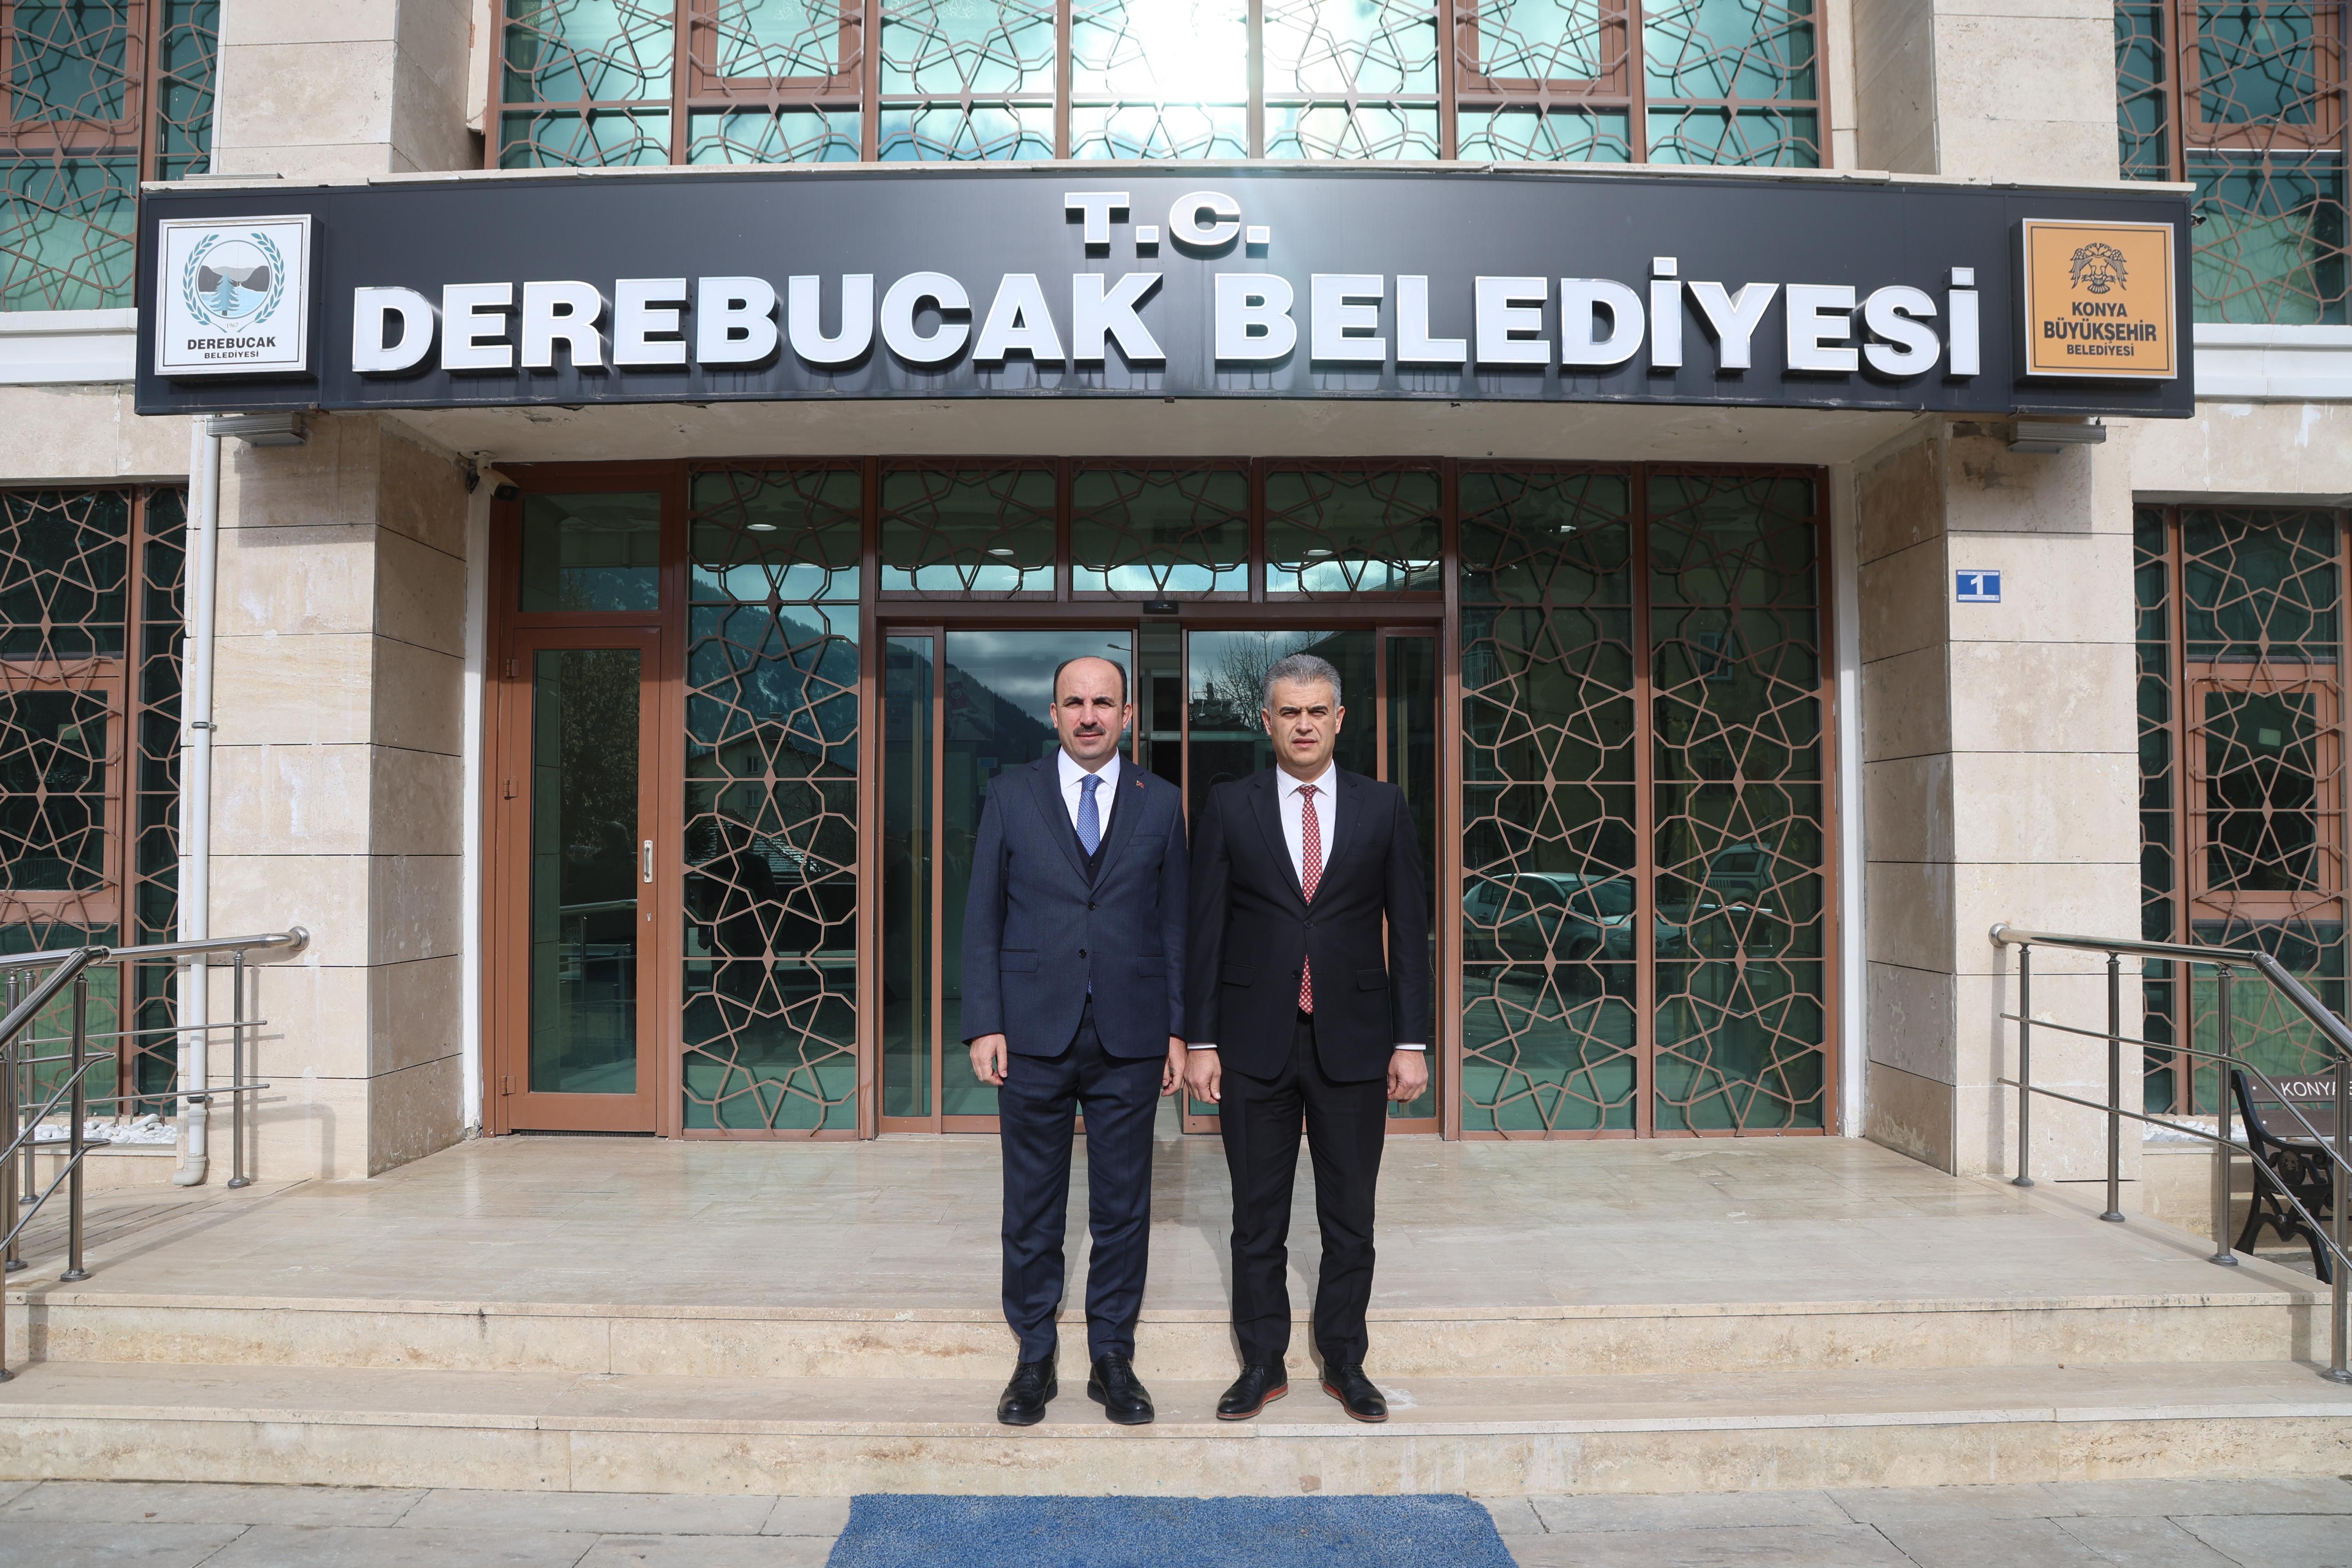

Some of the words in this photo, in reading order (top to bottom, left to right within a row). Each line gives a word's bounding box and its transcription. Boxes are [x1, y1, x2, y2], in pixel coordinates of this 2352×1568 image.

[1065, 191, 1271, 247] T.C.
[352, 271, 1166, 372] DEREBUCAK
[1215, 256, 1979, 375] BELEDİYESİ
[2072, 301, 2128, 317] KONYA
[2044, 317, 2157, 344] BÜYÜKŞEHİR
[187, 336, 276, 350] DEREBUCAK
[2067, 343, 2134, 357] BELEDİYESİ
[204, 349, 259, 359] BELEDİYESİ
[1970, 575, 1983, 595] 1
